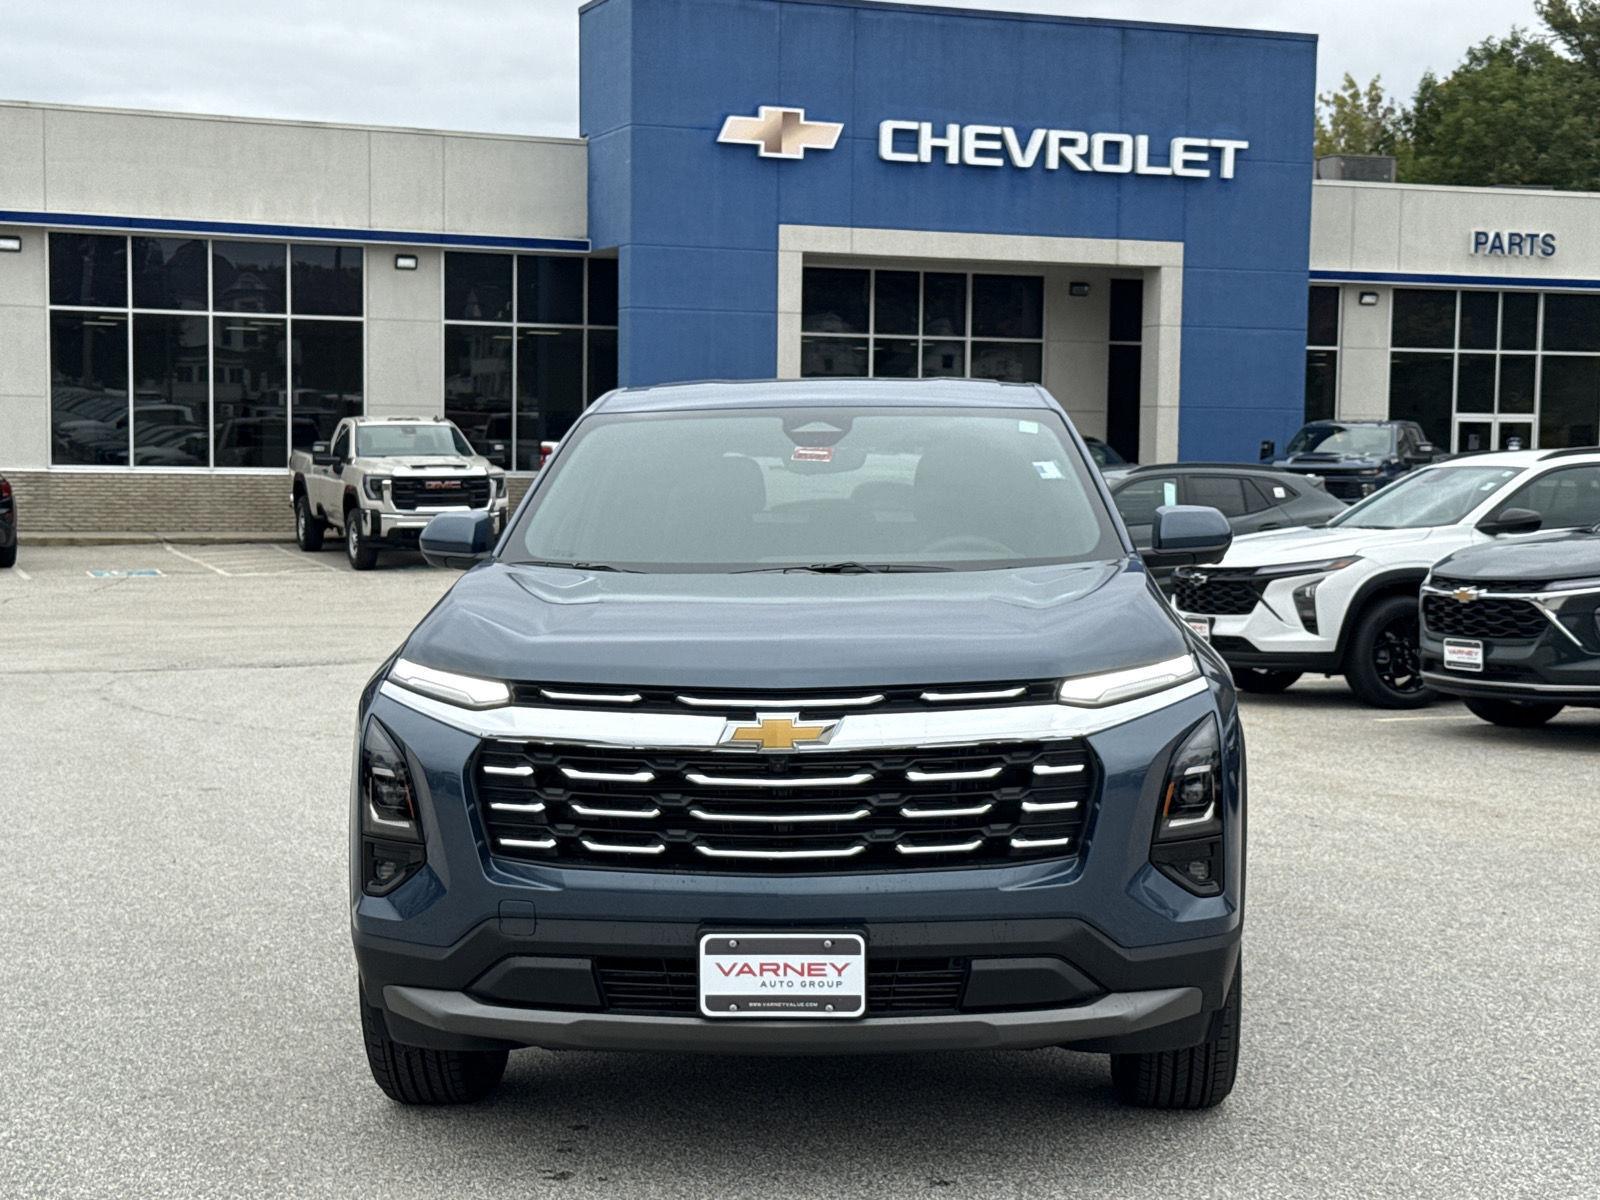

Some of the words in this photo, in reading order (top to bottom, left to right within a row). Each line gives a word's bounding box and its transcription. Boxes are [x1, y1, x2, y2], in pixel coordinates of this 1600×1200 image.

[879, 119, 1249, 179] CHEVROLET
[1473, 231, 1556, 256] PARTS
[425, 481, 461, 489] GMC
[715, 962, 850, 977] VARNEY
